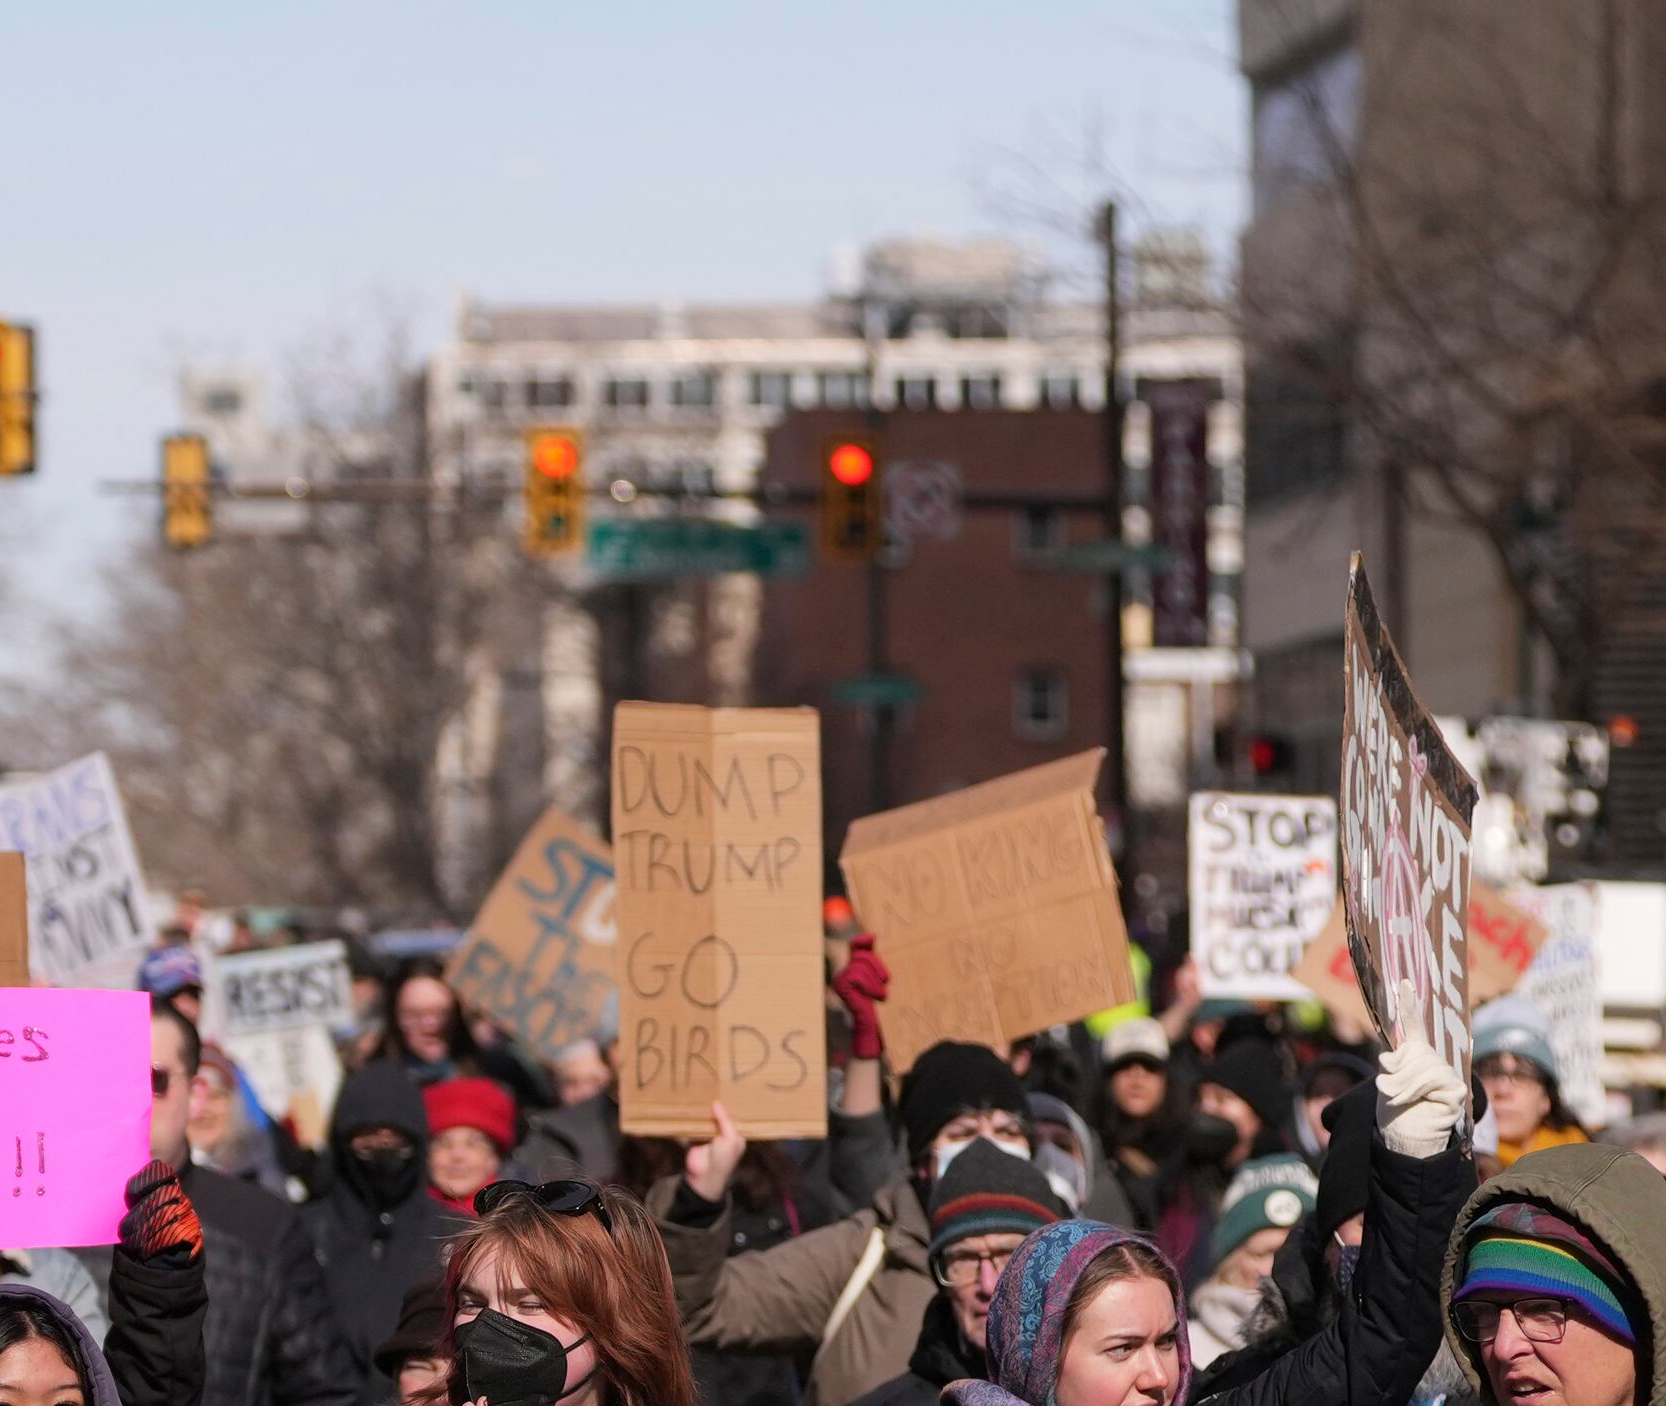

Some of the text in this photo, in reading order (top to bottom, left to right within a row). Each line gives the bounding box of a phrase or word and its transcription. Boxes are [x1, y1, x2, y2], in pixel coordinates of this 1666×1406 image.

[617, 744, 806, 821] DUMP
[619, 828, 803, 896] TRUMP
[1202, 797, 1332, 855] STOP
[1409, 785, 1470, 914] NOT
[515, 836, 616, 945] STO
[860, 848, 947, 936] NO
[627, 930, 740, 1010] GO
[635, 1016, 810, 1093] BIRDS
